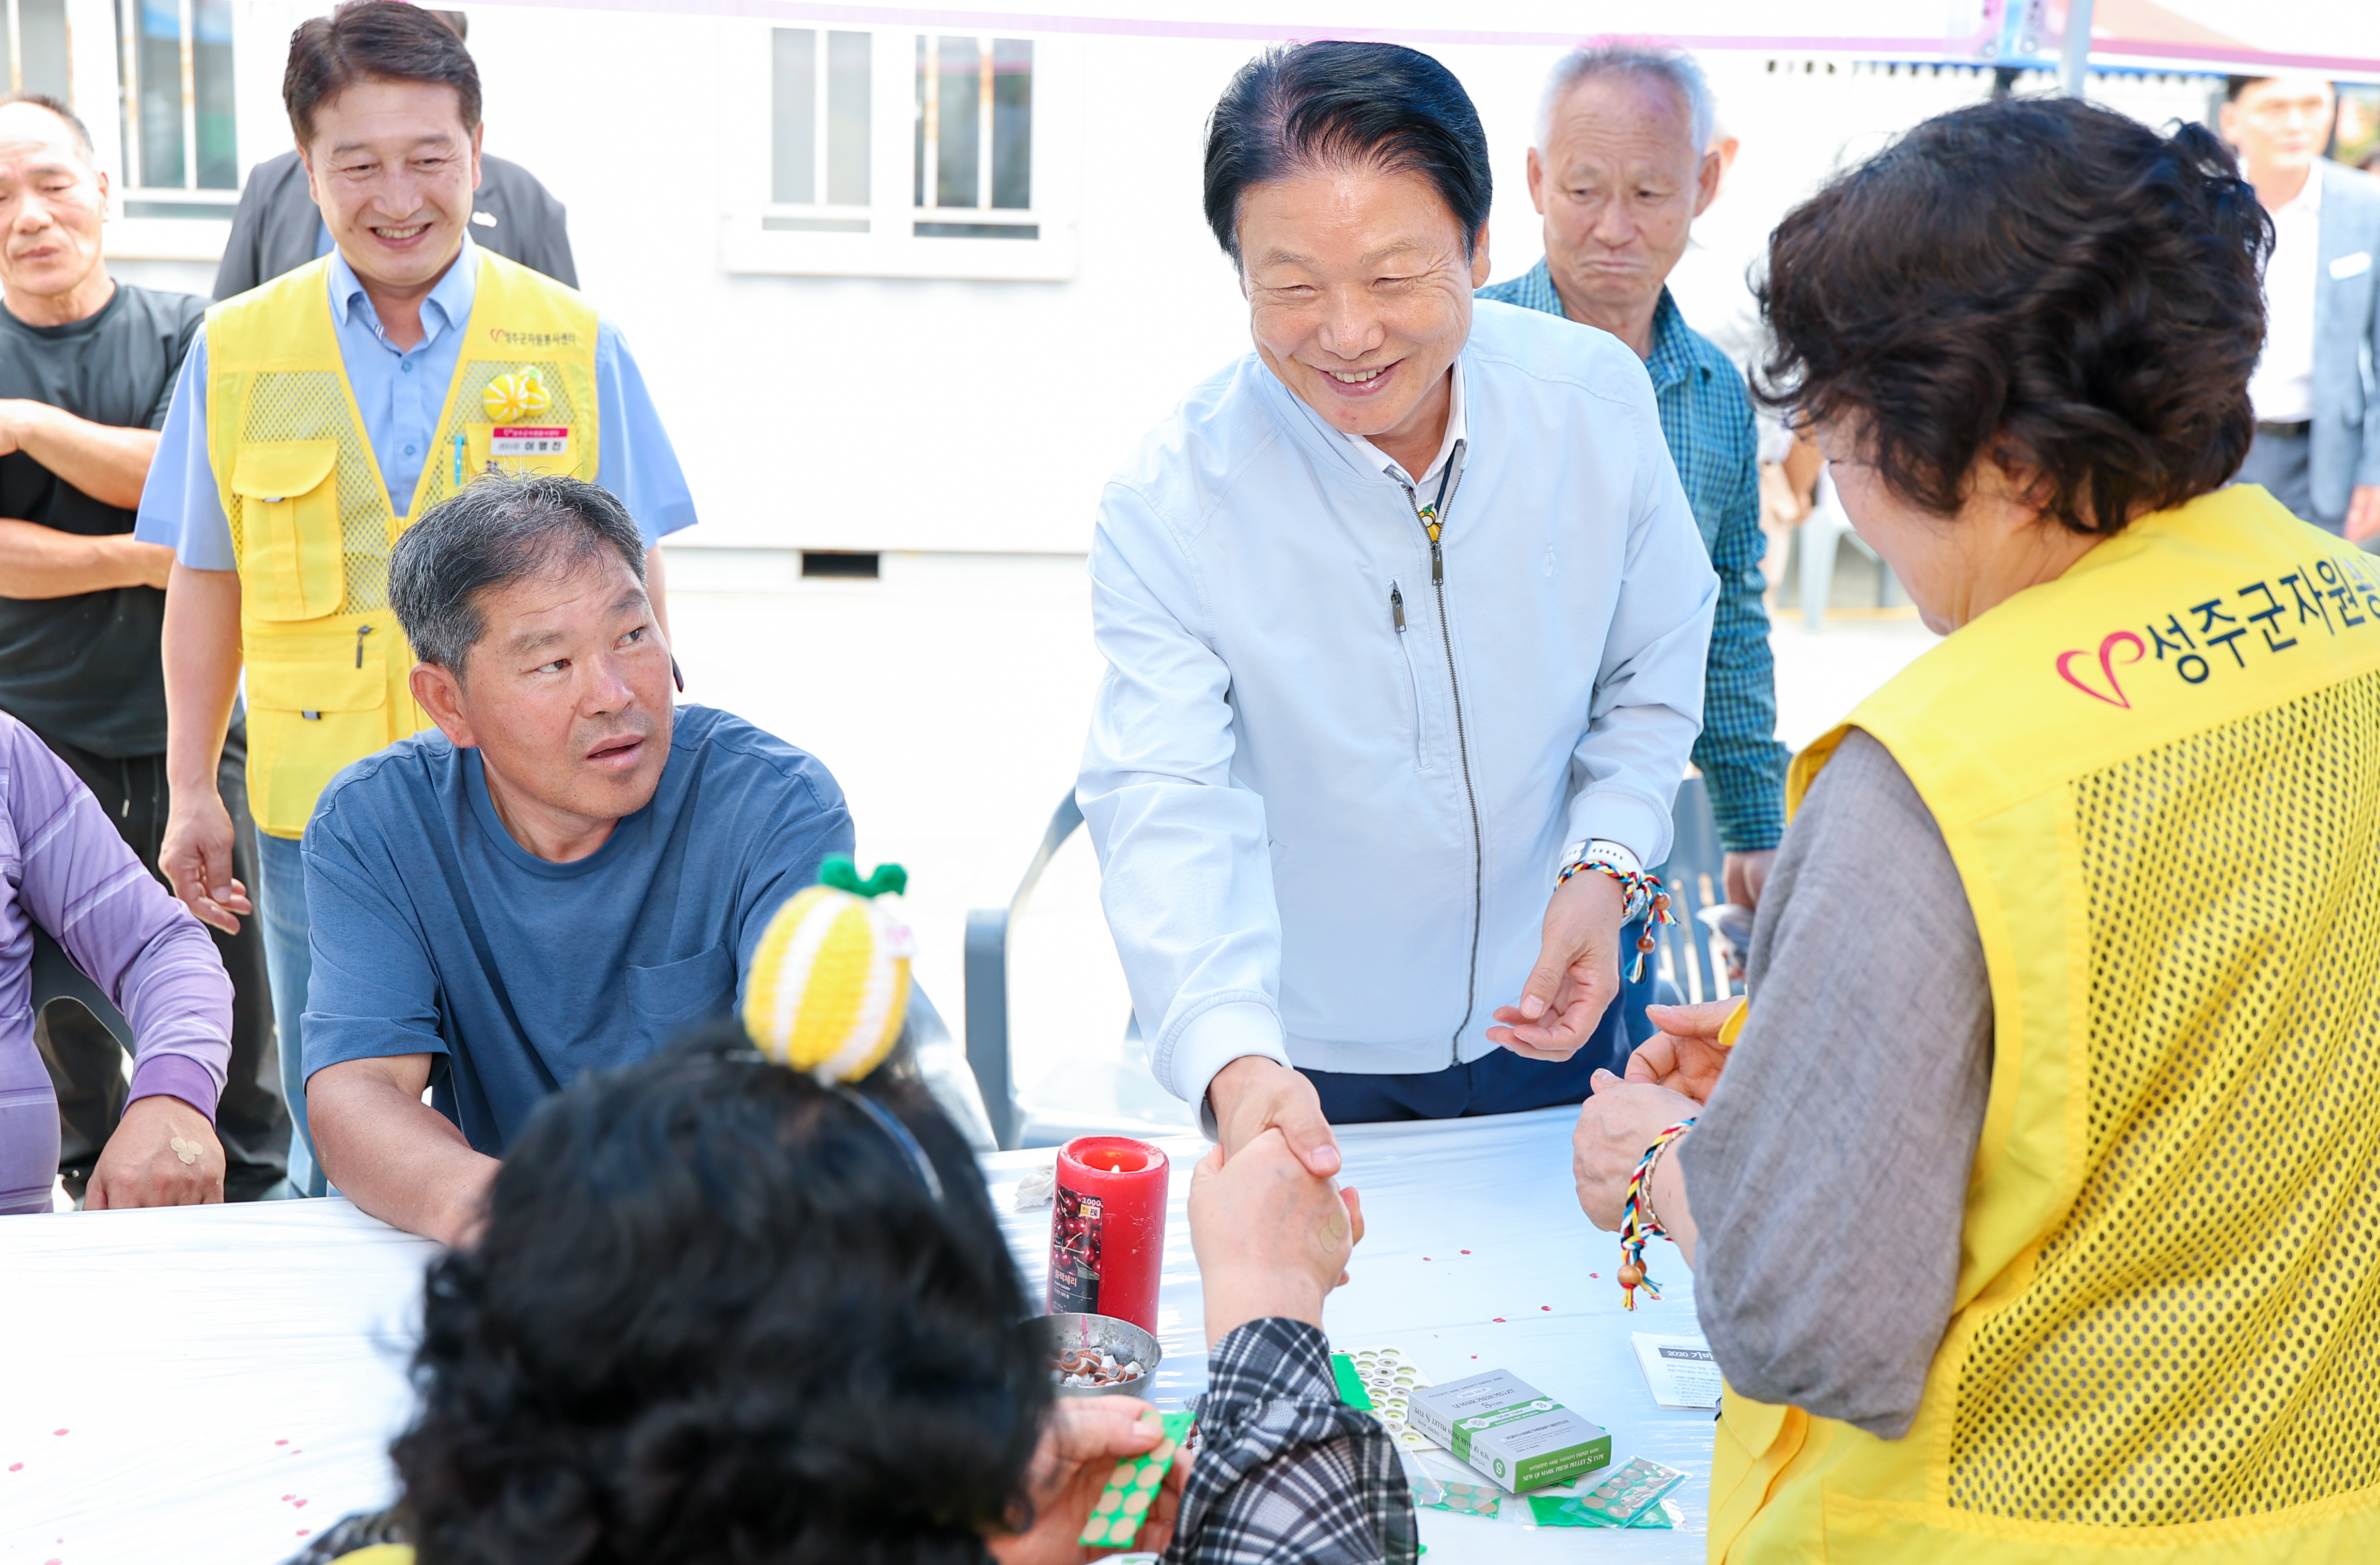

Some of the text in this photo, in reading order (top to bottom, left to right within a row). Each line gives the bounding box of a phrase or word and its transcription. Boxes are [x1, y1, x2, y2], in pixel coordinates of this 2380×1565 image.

[1055, 1268, 1077, 1287] 블랙체리
[1690, 1351, 1714, 1360] 기마
[1459, 1399, 1478, 1407] MARK
[1476, 1394, 1495, 1402] PRESS
[1493, 1388, 1515, 1397] PELLET
[1417, 1419, 1427, 1428] MARK
[1549, 1419, 1570, 1428] INSTITUTE
[1414, 1406, 1490, 1461] NEW QI MARK PRESS PELLET S TYPE
[1427, 1426, 1440, 1437] ENERGY
[1457, 1445, 1466, 1455] HAND
[1495, 1462, 1502, 1475] S
[1529, 1462, 1548, 1471] KHT(KORYO
[1559, 1454, 1575, 1463] THERAPY)
[1541, 1468, 1555, 1476] MARK
[1569, 1459, 1586, 1468] PELLET
[1587, 1456, 1592, 1464] S
